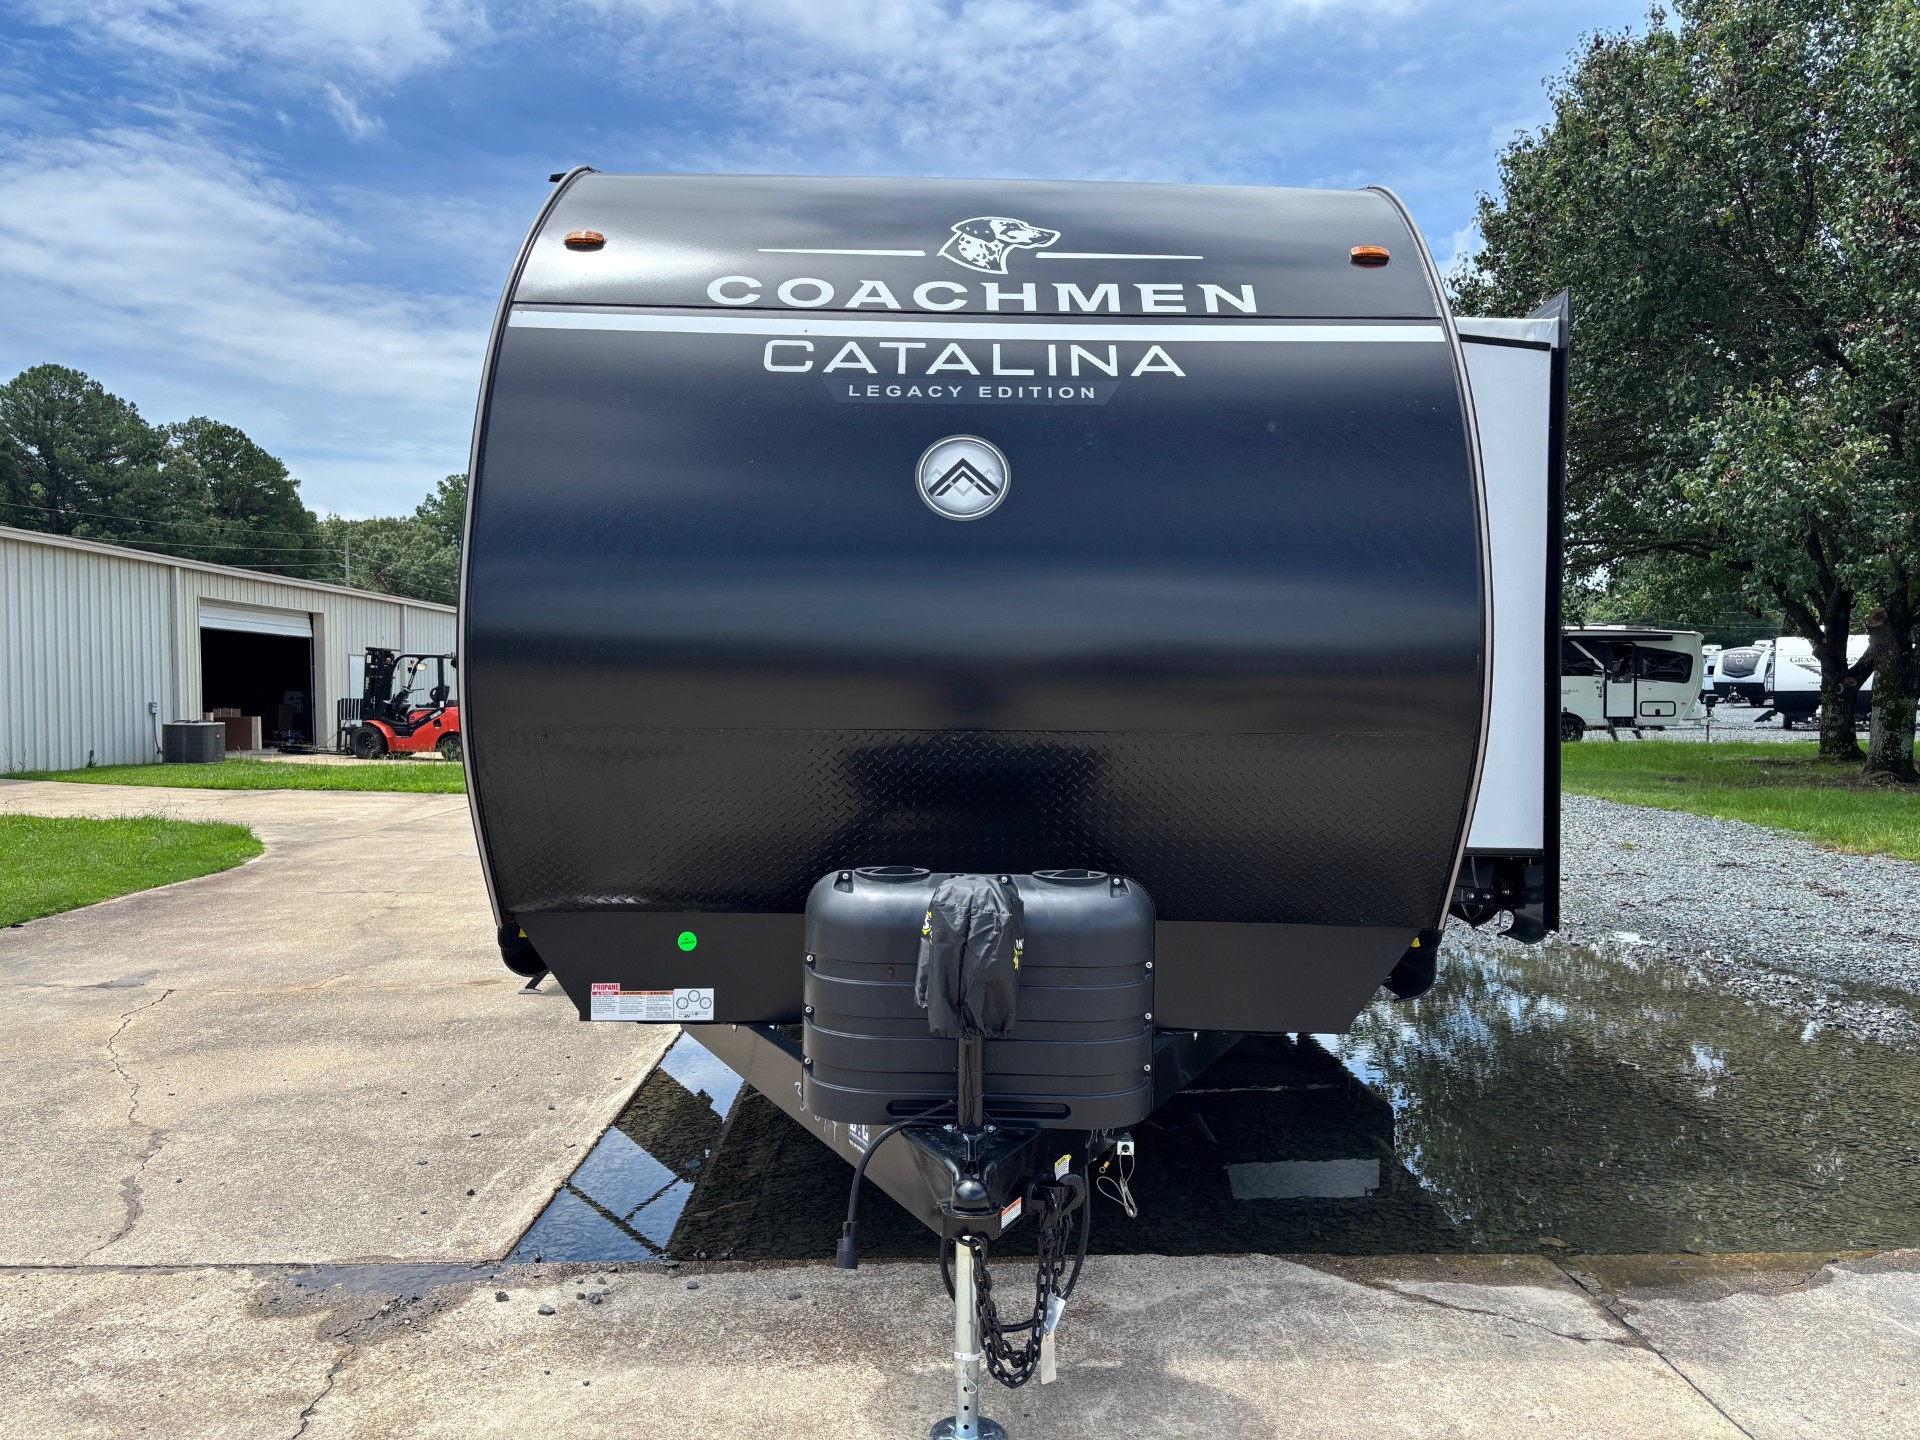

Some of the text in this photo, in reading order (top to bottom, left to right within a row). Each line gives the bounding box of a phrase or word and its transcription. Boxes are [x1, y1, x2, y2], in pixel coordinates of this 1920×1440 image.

[706, 275, 1257, 313] COACHMEN
[763, 339, 1187, 377] CATALINA
[848, 384, 1095, 399] LEGACY EDITION
